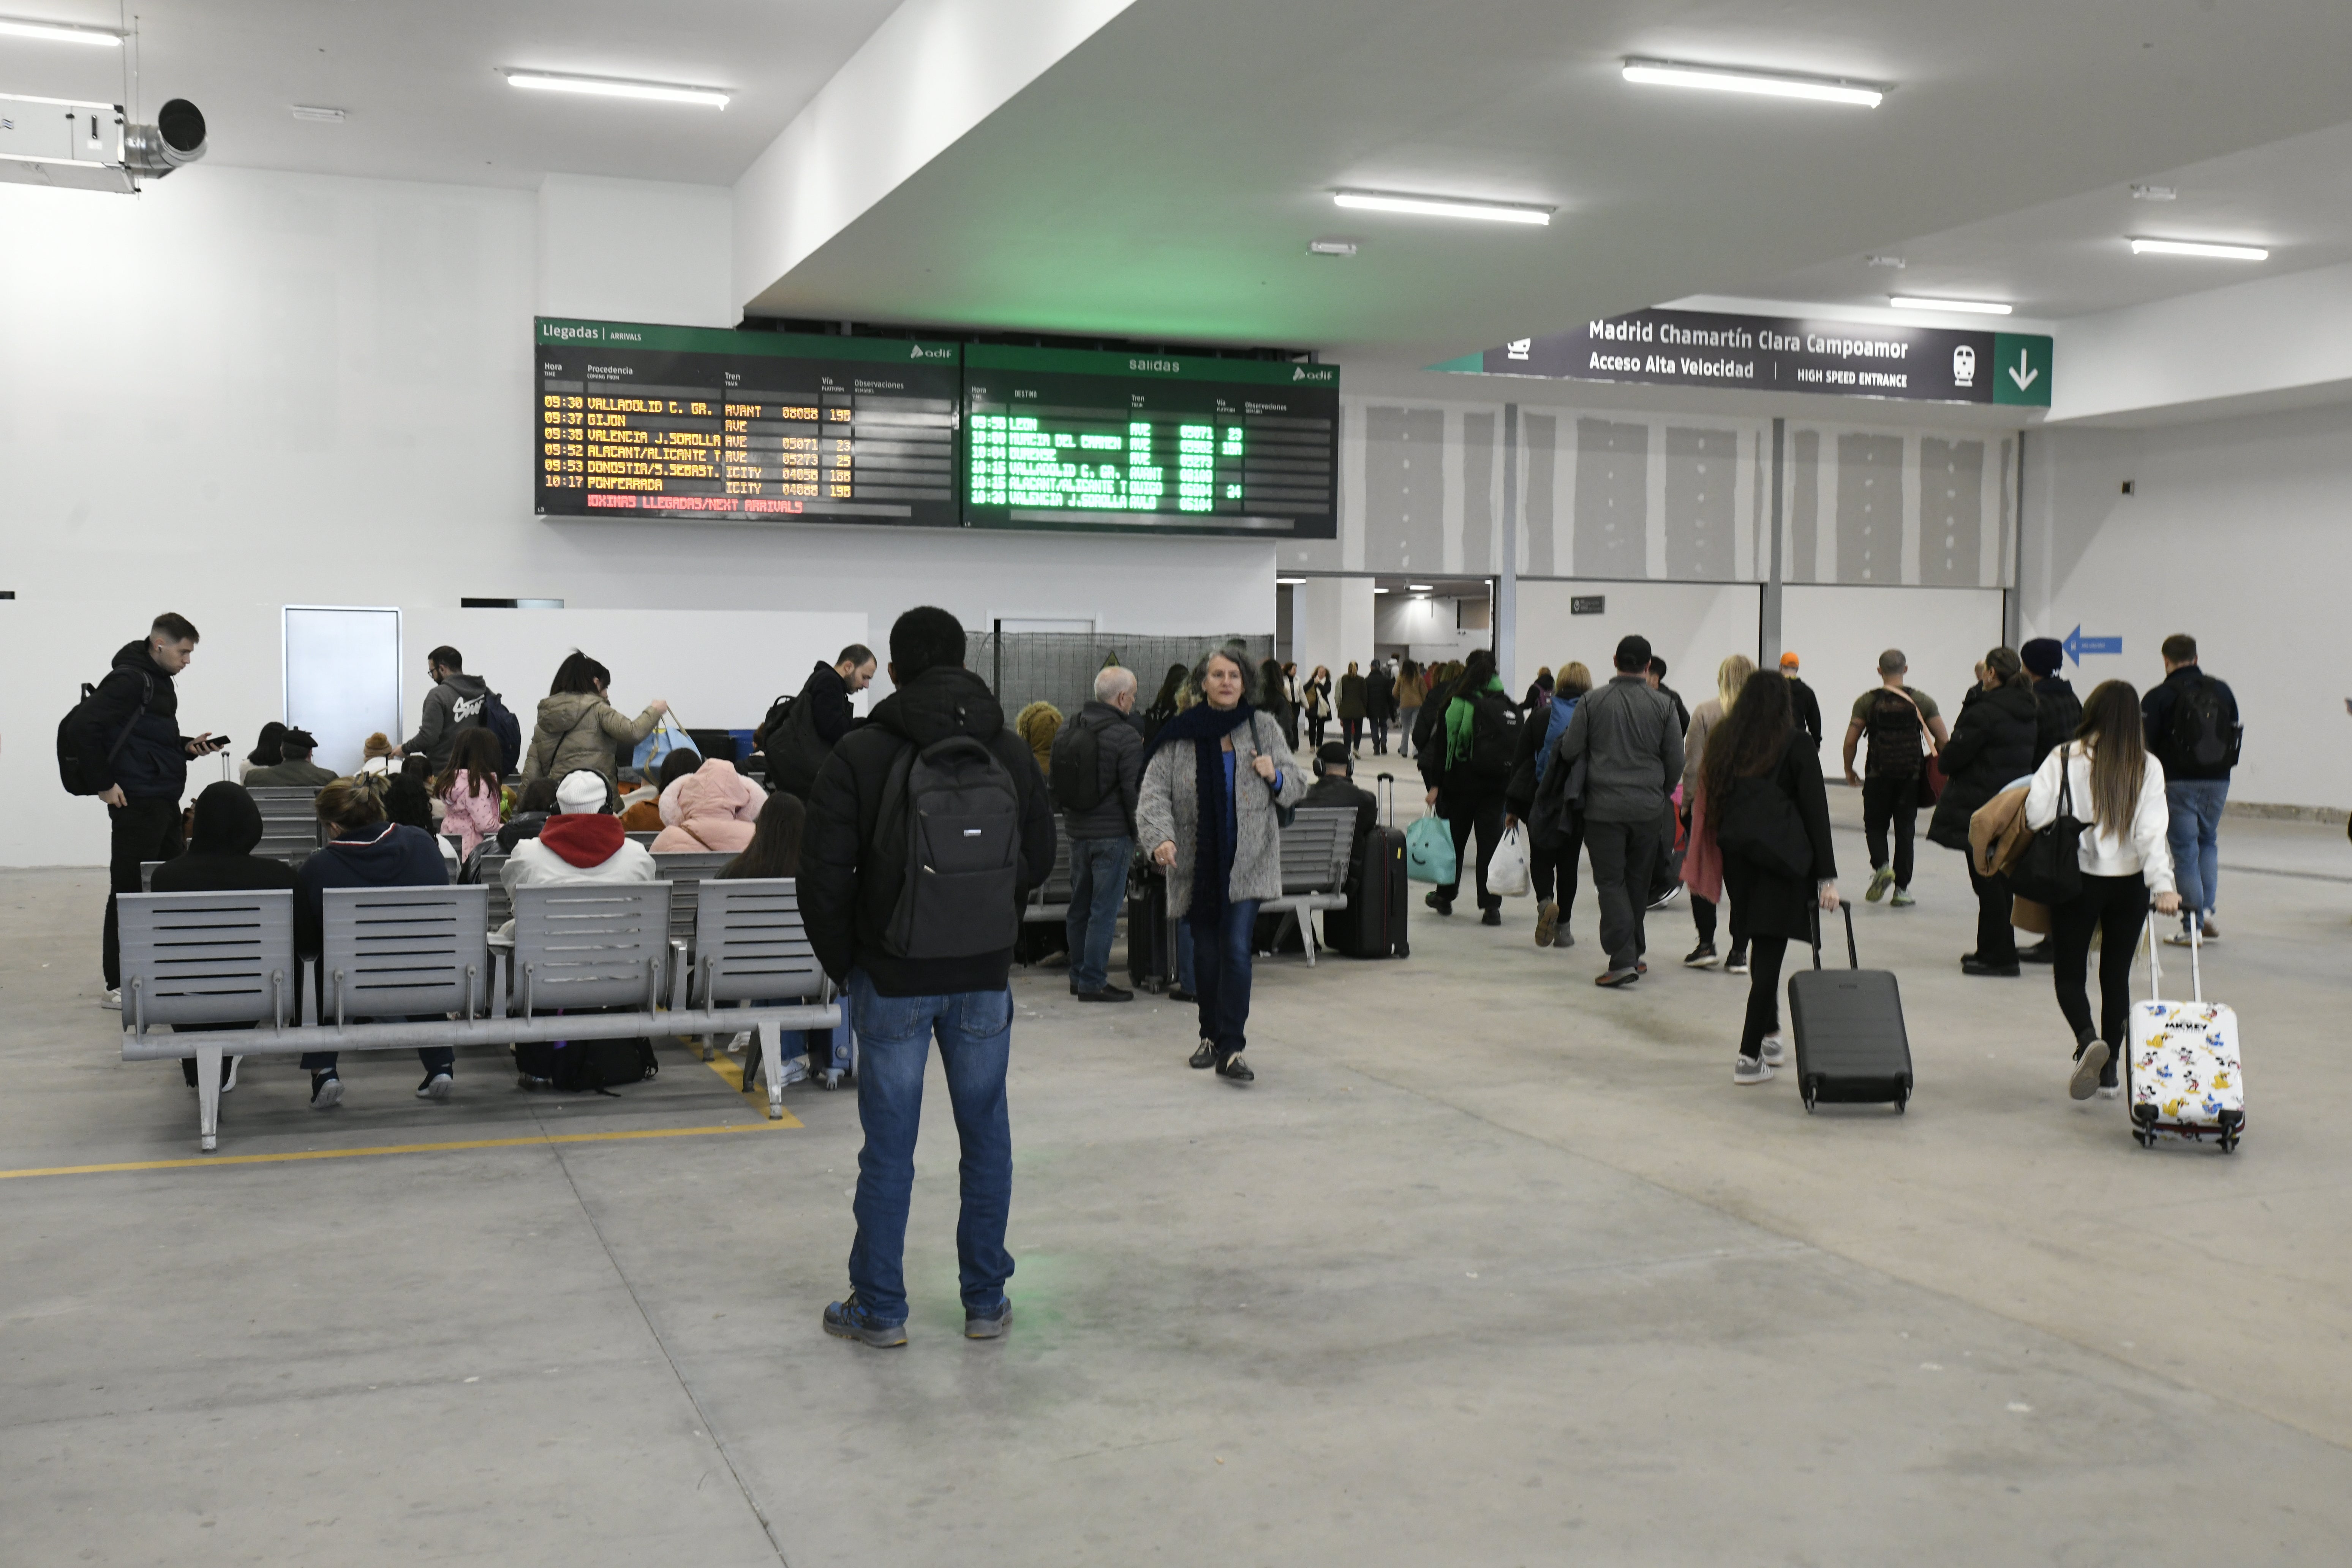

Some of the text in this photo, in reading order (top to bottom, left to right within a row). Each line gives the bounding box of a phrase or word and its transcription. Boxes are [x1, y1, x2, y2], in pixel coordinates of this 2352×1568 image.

[544, 324, 641, 341] Llegadas ARRIVALS
[1589, 319, 1908, 359] Madrid Chamartín Clara Campoamor
[925, 349, 952, 358] adif
[544, 362, 562, 371] Hora
[588, 365, 633, 375] Procedencia
[1589, 351, 1753, 379] Acceso Alta Velocidad
[725, 372, 740, 381] Tren
[855, 379, 904, 389] Observaciones
[1307, 371, 1333, 380] adif
[1797, 368, 1907, 388] HIGH SPEED ENTRANCE
[1015, 389, 1037, 398] DESTINO
[545, 395, 583, 409] 09:30
[588, 397, 662, 413] VALLADOLID
[669, 401, 683, 413] C.
[691, 402, 712, 415] GR.
[725, 404, 761, 417] AVANT
[545, 411, 747, 433] 09:37 GIJON AVE
[1009, 417, 1037, 430] LEON
[1129, 422, 1151, 436] AVE
[1180, 425, 1213, 439] 05071
[1228, 428, 1242, 441] 23
[588, 429, 648, 443] VALENCIA
[655, 432, 721, 447] J.SOROLLA
[725, 435, 747, 448] AVE
[782, 438, 818, 450] 05071
[836, 439, 851, 452] 23
[972, 430, 1006, 444] 10:00
[1009, 432, 1050, 446] MURCIA
[1055, 434, 1076, 447] DEL
[1080, 435, 1121, 449] CARMEN
[1129, 437, 1151, 450] AVE
[545, 443, 851, 467] 09:52 ALACANT/ALICANTE T AVE 05273 25
[972, 445, 1213, 468] 10:04 OURENSE AVE 05273
[545, 459, 583, 472] 09:53
[588, 461, 719, 477] DONOSTIA/S.SEBAST.
[726, 467, 761, 479] ICITY
[972, 460, 1006, 474] 10:15
[1009, 462, 1075, 477] VALLADOLID
[1081, 464, 1095, 478] C.
[1100, 465, 1120, 479] GR.
[1129, 466, 1163, 481] AVANT
[545, 475, 583, 488] 10:17
[588, 476, 662, 491] PONFERRADA
[726, 482, 761, 494] ICITY
[972, 475, 1006, 489] 10:15
[1009, 476, 1114, 493] ALACANT/ALICANTE
[1121, 481, 1127, 494] T
[1129, 481, 1163, 495] OUIGO
[1227, 485, 1241, 498] 24
[643, 496, 738, 511] LLEGADAS/NEXT
[744, 499, 802, 513] ARRIVALS
[972, 490, 1006, 504] 10:30
[1009, 491, 1063, 506] VALENCIA
[1068, 493, 1127, 508] J.SOROLLA
[1129, 495, 1156, 509] AVLO
